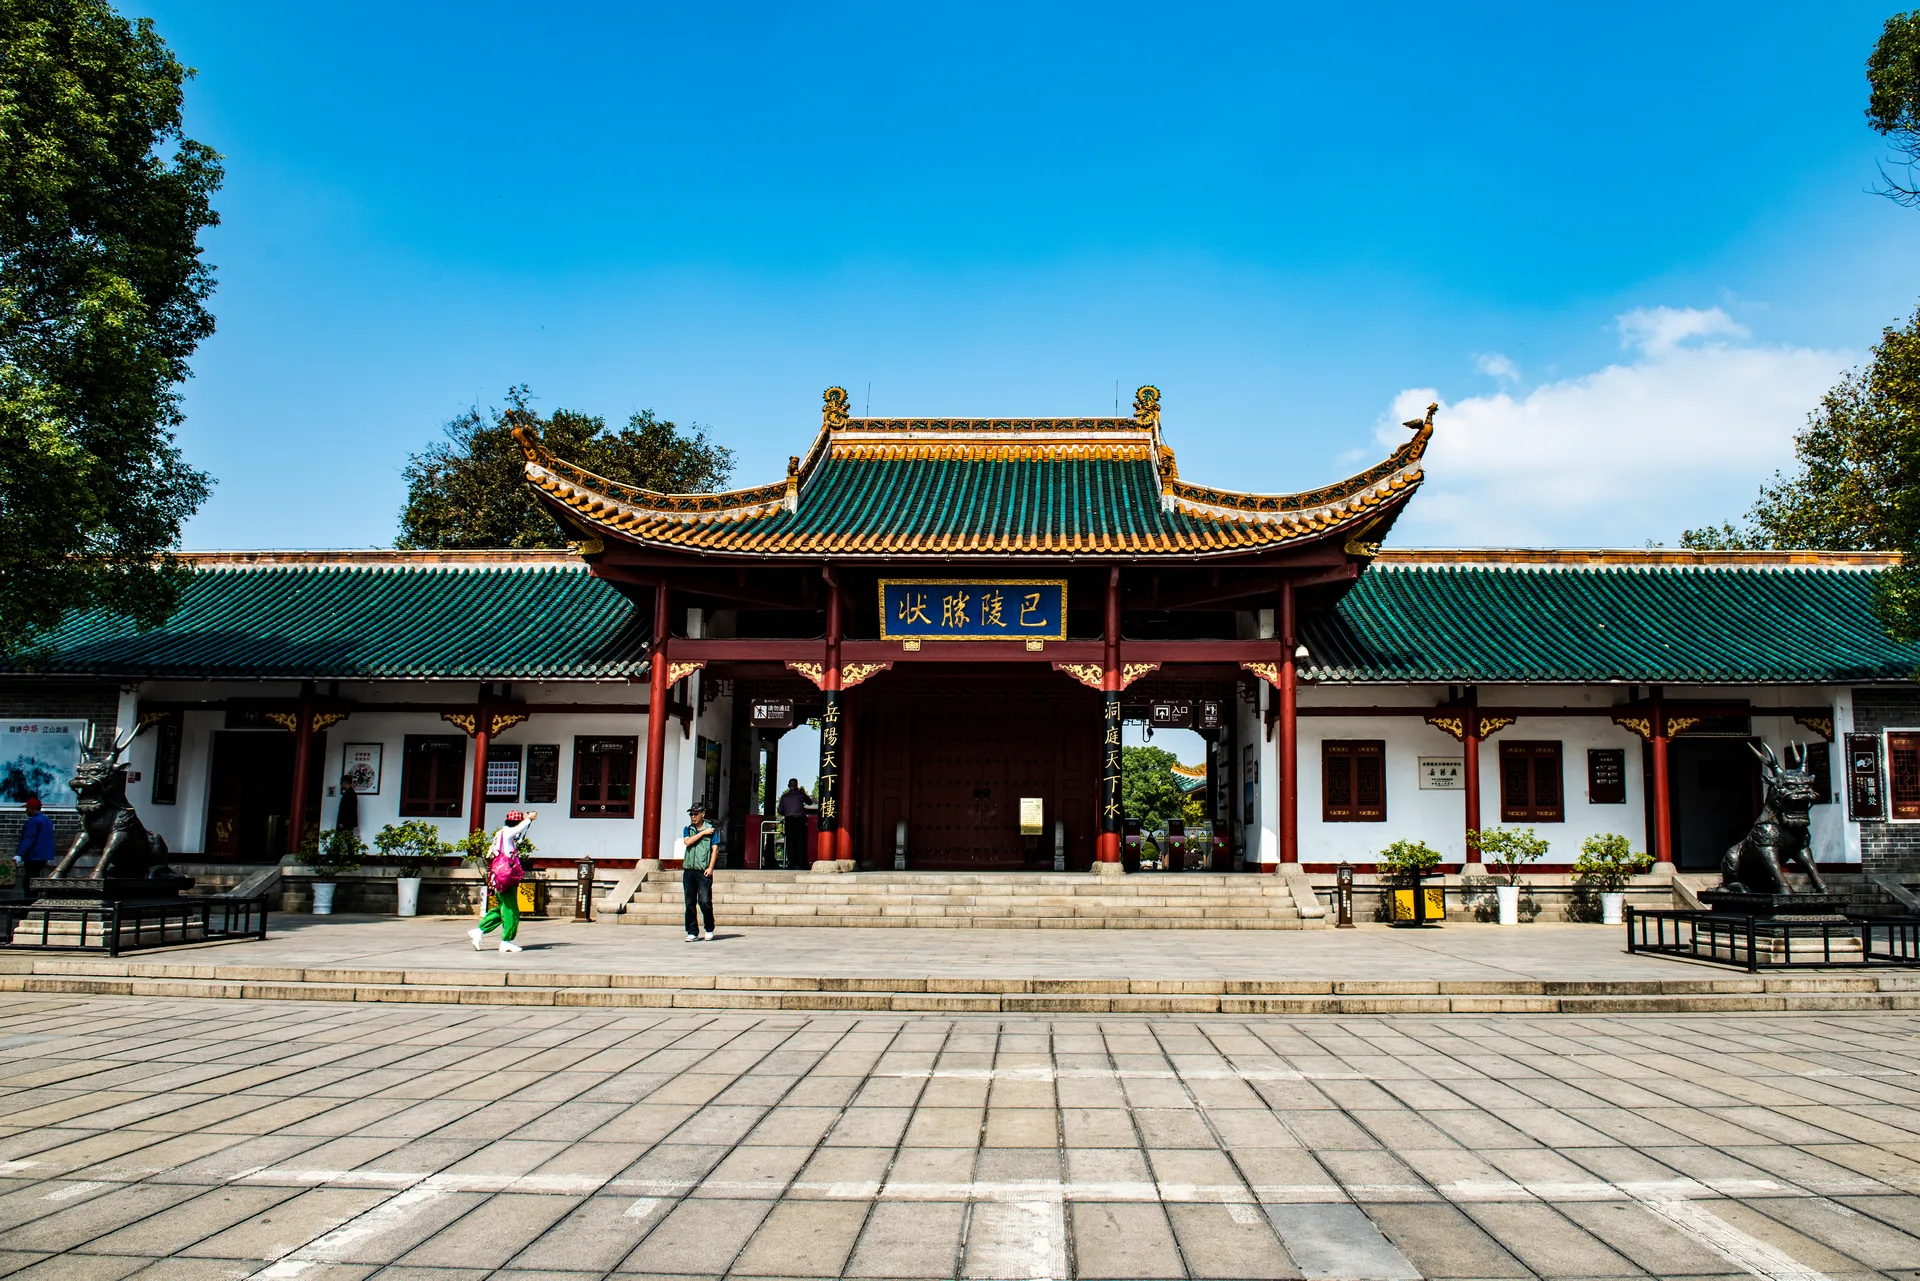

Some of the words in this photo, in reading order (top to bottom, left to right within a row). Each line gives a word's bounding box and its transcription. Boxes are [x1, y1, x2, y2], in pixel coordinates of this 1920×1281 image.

[1171, 705, 1188, 714] 入口
[1103, 701, 1121, 819] 洞庭天下水
[1867, 777, 1877, 806] 售票处
